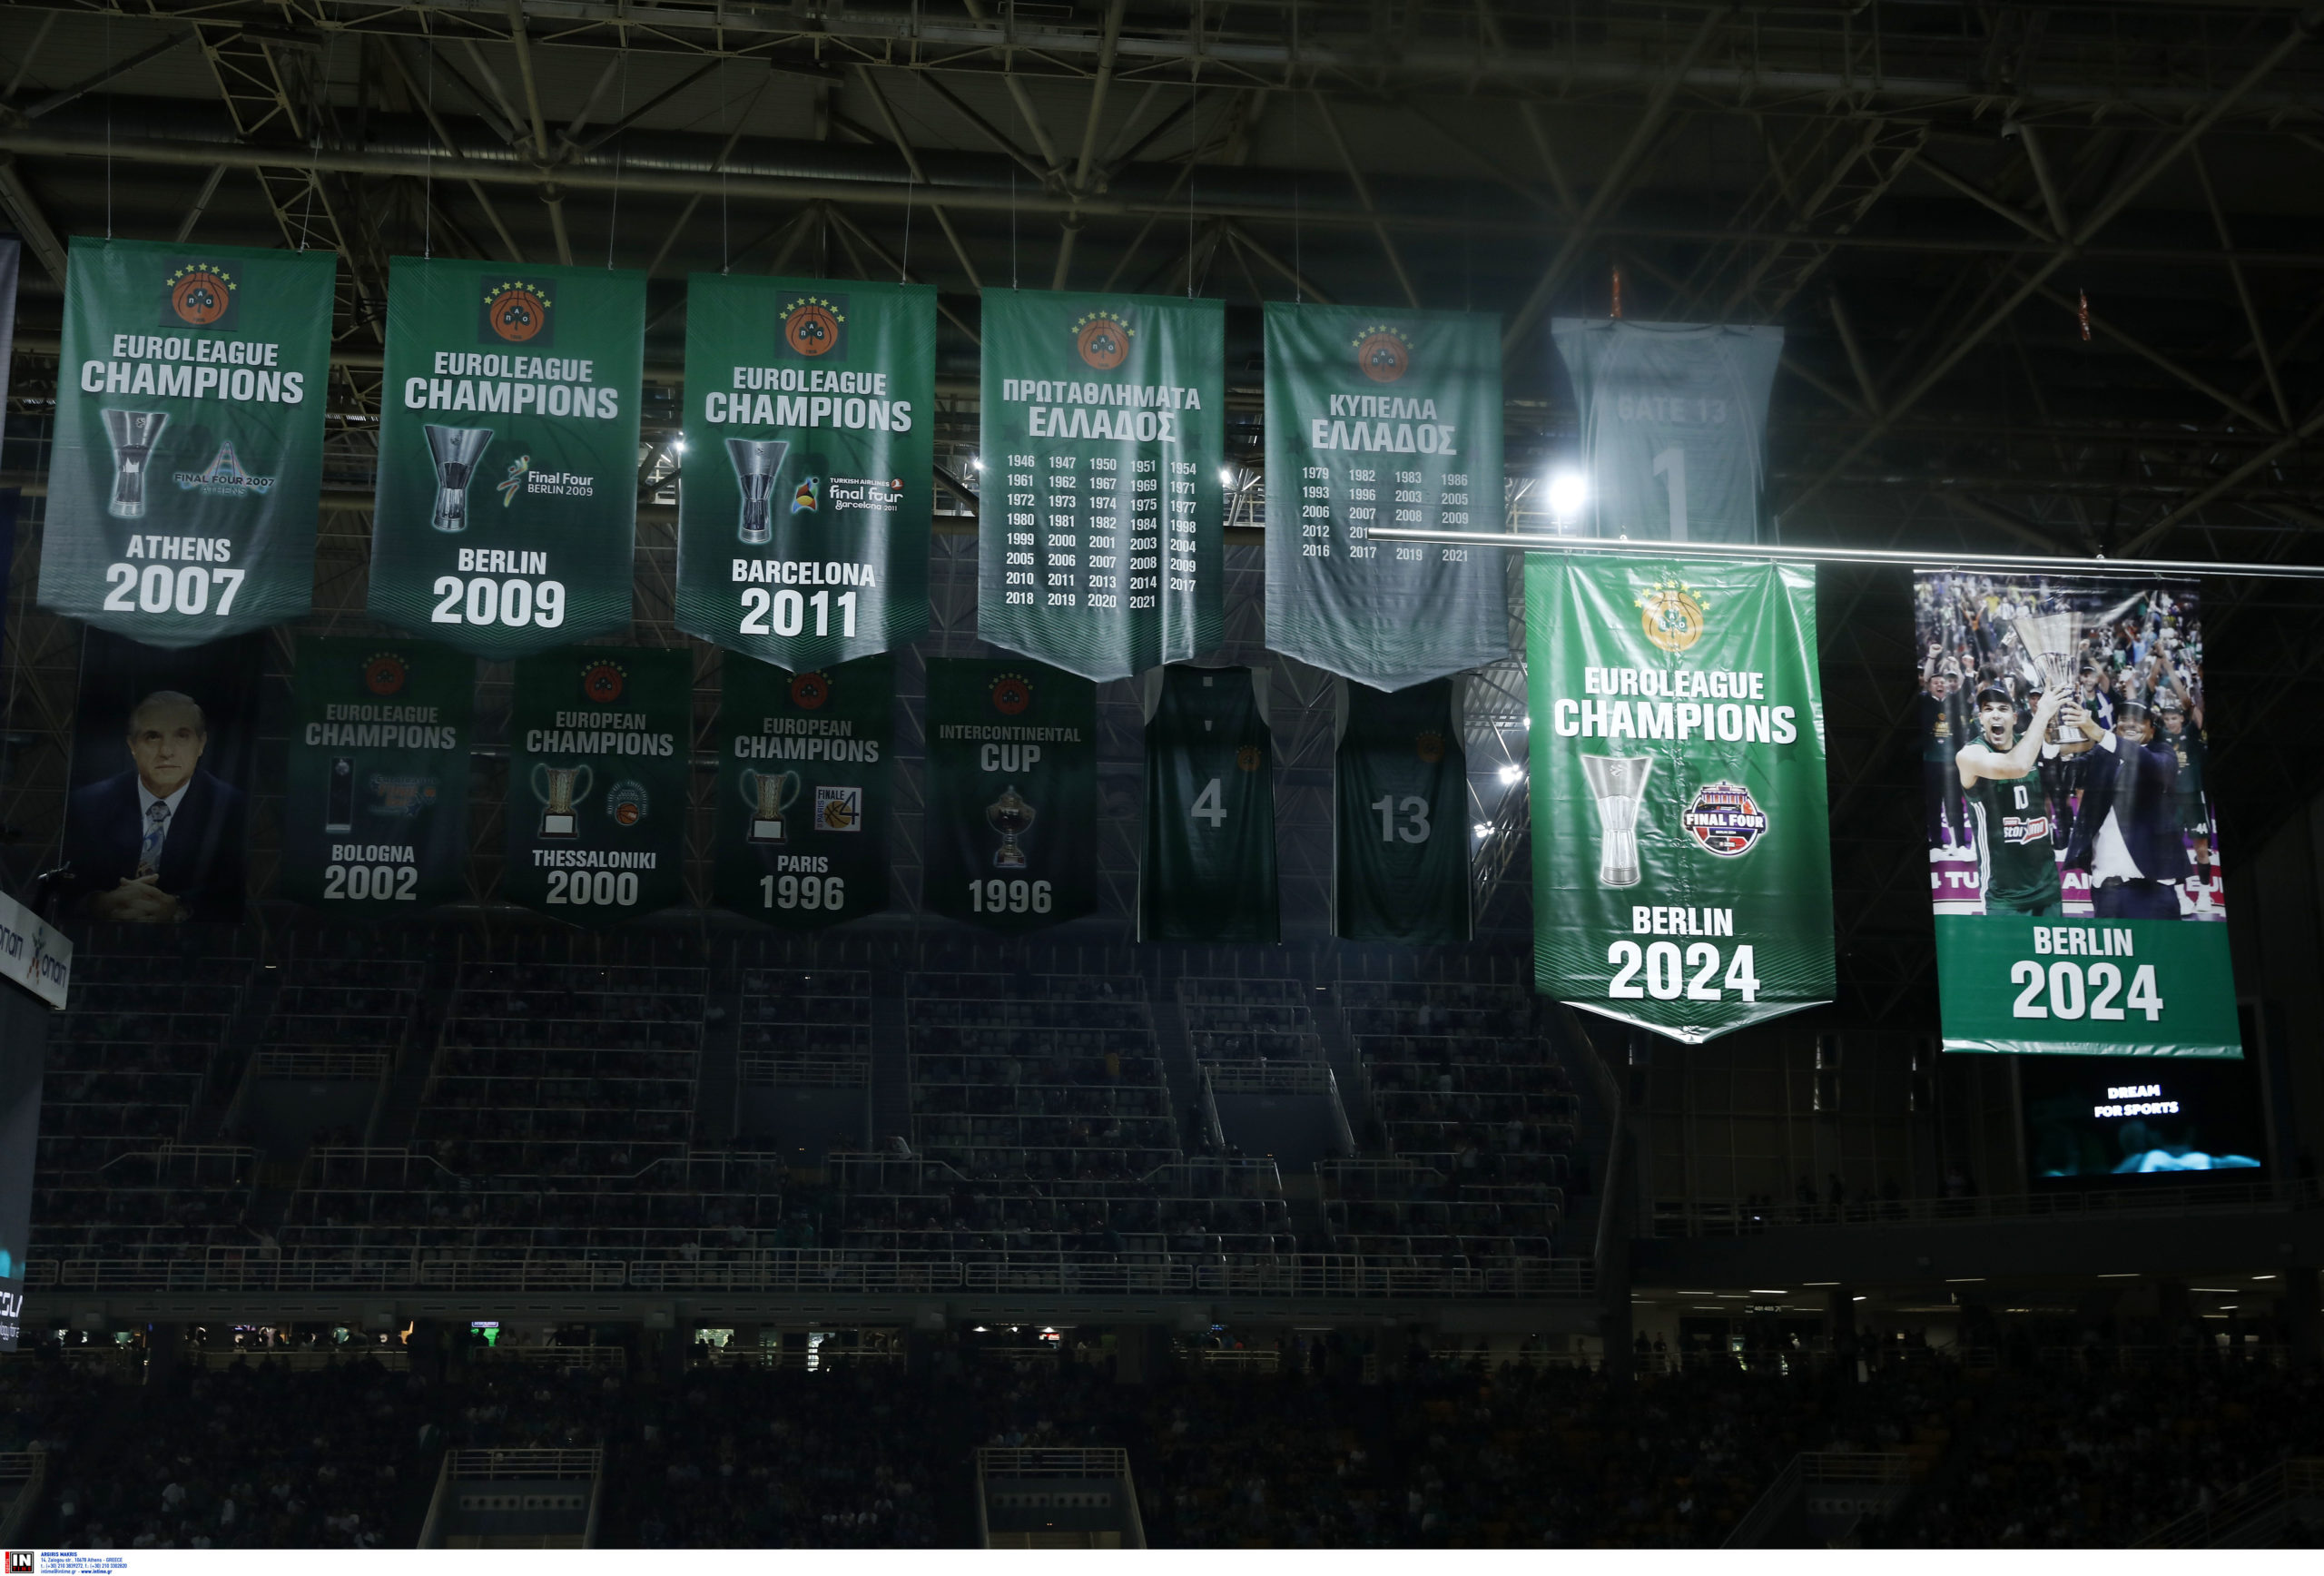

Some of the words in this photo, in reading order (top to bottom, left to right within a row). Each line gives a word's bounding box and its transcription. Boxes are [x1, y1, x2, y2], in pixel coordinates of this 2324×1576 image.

[113, 334, 279, 367] EUROLEAGUE
[434, 351, 593, 382] EUROLEAGUE
[81, 360, 304, 404] CHAMPIONS
[733, 366, 887, 397] EUROLEAGUE
[1002, 379, 1201, 411] ΠΡΩΤΑΘΛΗΜΑΤΑ
[404, 376, 618, 419] CHAMPIONS
[1329, 393, 1437, 420] ΚΥΠΕΛΛΑ
[1619, 395, 1686, 422] GATE
[704, 391, 912, 432] CHAMPIONS
[1029, 406, 1176, 443] ΕΛΛΑΔΟΣ
[1311, 419, 1457, 456] ΕΛΛΑΔΟΣ
[528, 471, 560, 484] Final
[563, 473, 594, 486] Four
[1007, 455, 1035, 468] 1946
[1049, 457, 1076, 469] 1947
[1089, 458, 1117, 470] 1950
[1130, 460, 1156, 472] 1951
[1170, 462, 1196, 475] 1954
[1303, 467, 1329, 479] 1979
[1349, 469, 1375, 482] 1982
[1395, 471, 1422, 484] 1983
[1441, 474, 1468, 486] 1986
[174, 473, 209, 483] FINAL
[212, 476, 243, 485] FOUR
[246, 478, 274, 487] 2007
[202, 486, 246, 495] ATHENS
[527, 484, 563, 494] BERLIN
[566, 486, 593, 496] 2009
[1007, 474, 1033, 487] 1961
[1049, 476, 1076, 488] 1962
[1089, 478, 1117, 490] 1967
[1130, 479, 1157, 492] 1969
[1170, 481, 1196, 494] 1971
[830, 485, 864, 499] final
[868, 487, 903, 503] four
[835, 500, 881, 510] Barcelona
[1007, 494, 1035, 507] 1972
[1049, 495, 1076, 507] 1973
[1089, 497, 1117, 509] 1974
[1130, 498, 1157, 511] 1975
[1170, 500, 1196, 514] 1977
[1303, 487, 1329, 498] 1993
[1349, 488, 1375, 500] 1996
[1395, 490, 1422, 502] 2003
[1442, 493, 1468, 505] 2005
[1007, 513, 1035, 526] 1980
[1049, 515, 1075, 527] 1981
[1089, 517, 1117, 529] 1982
[1130, 517, 1157, 531] 1984
[1170, 519, 1196, 533] 1998
[1303, 506, 1329, 518] 2006
[1349, 507, 1376, 519] 2007
[1395, 509, 1422, 522] 2008
[1442, 512, 1469, 524] 2009
[1007, 533, 1035, 545] 1999
[1048, 534, 1076, 547] 2000
[1089, 536, 1116, 548] 2001
[1130, 537, 1157, 550] 2003
[1170, 538, 1196, 553] 2004
[1303, 525, 1329, 537] 2012
[1350, 527, 1369, 538] 201
[126, 534, 231, 563] ATHENS
[458, 548, 547, 575] BERLIN
[1006, 552, 1034, 565] 2005
[1048, 554, 1076, 566] 2006
[1089, 556, 1117, 568] 2007
[1130, 557, 1157, 570] 2008
[1170, 557, 1196, 572] 2009
[1303, 545, 1330, 557] 2016
[1350, 546, 1376, 558] 2017
[1396, 548, 1423, 561] 2019
[1443, 549, 1468, 562] 2021
[732, 559, 876, 587] BARCELONA
[1006, 572, 1034, 585] 2010
[1048, 573, 1075, 586] 2011
[1089, 575, 1117, 588] 2013
[1130, 576, 1157, 589] 2014
[1170, 577, 1196, 592] 2017
[103, 561, 245, 616] 2007
[431, 576, 566, 628] 2009
[1006, 592, 1034, 605] 2018
[1048, 593, 1076, 606] 2019
[1088, 594, 1117, 608] 2020
[1130, 596, 1156, 608] 2021
[740, 588, 857, 637] 2011
[1584, 666, 1764, 701] EUROLEAGUE
[326, 704, 438, 724] EUROLEAGUE
[556, 711, 646, 730] EUROPEAN
[763, 717, 852, 736] EUROPEAN
[1554, 699, 1797, 745] CHAMPIONS
[305, 723, 457, 750] CHAMPIONS
[527, 729, 675, 756] CHAMPIONS
[940, 724, 1081, 743] INTERCONTINENTAL
[734, 735, 879, 763] CHAMPIONS
[980, 744, 1041, 773] CUP
[818, 789, 845, 800] FINALE
[1190, 778, 1227, 828] 4
[1372, 795, 1432, 843] 13
[1686, 813, 1727, 826] FINAL
[1728, 814, 1764, 828] FOUR
[332, 844, 415, 862] BOLOGNA
[532, 850, 656, 869] THESSALONIKI
[777, 855, 828, 873] PARIS
[323, 865, 419, 901] 2002
[546, 870, 639, 906] 2000
[760, 875, 844, 911] 1996
[969, 879, 1052, 914] 1996
[1632, 905, 1734, 938] BERLIN
[2034, 927, 2133, 957] BERLIN
[1607, 940, 1761, 1003] 2024
[2010, 960, 2163, 1023] 2024
[2108, 1085, 2161, 1099] DREAM
[2094, 1106, 2122, 1118] FOR
[2123, 1101, 2179, 1116] SPORTS
